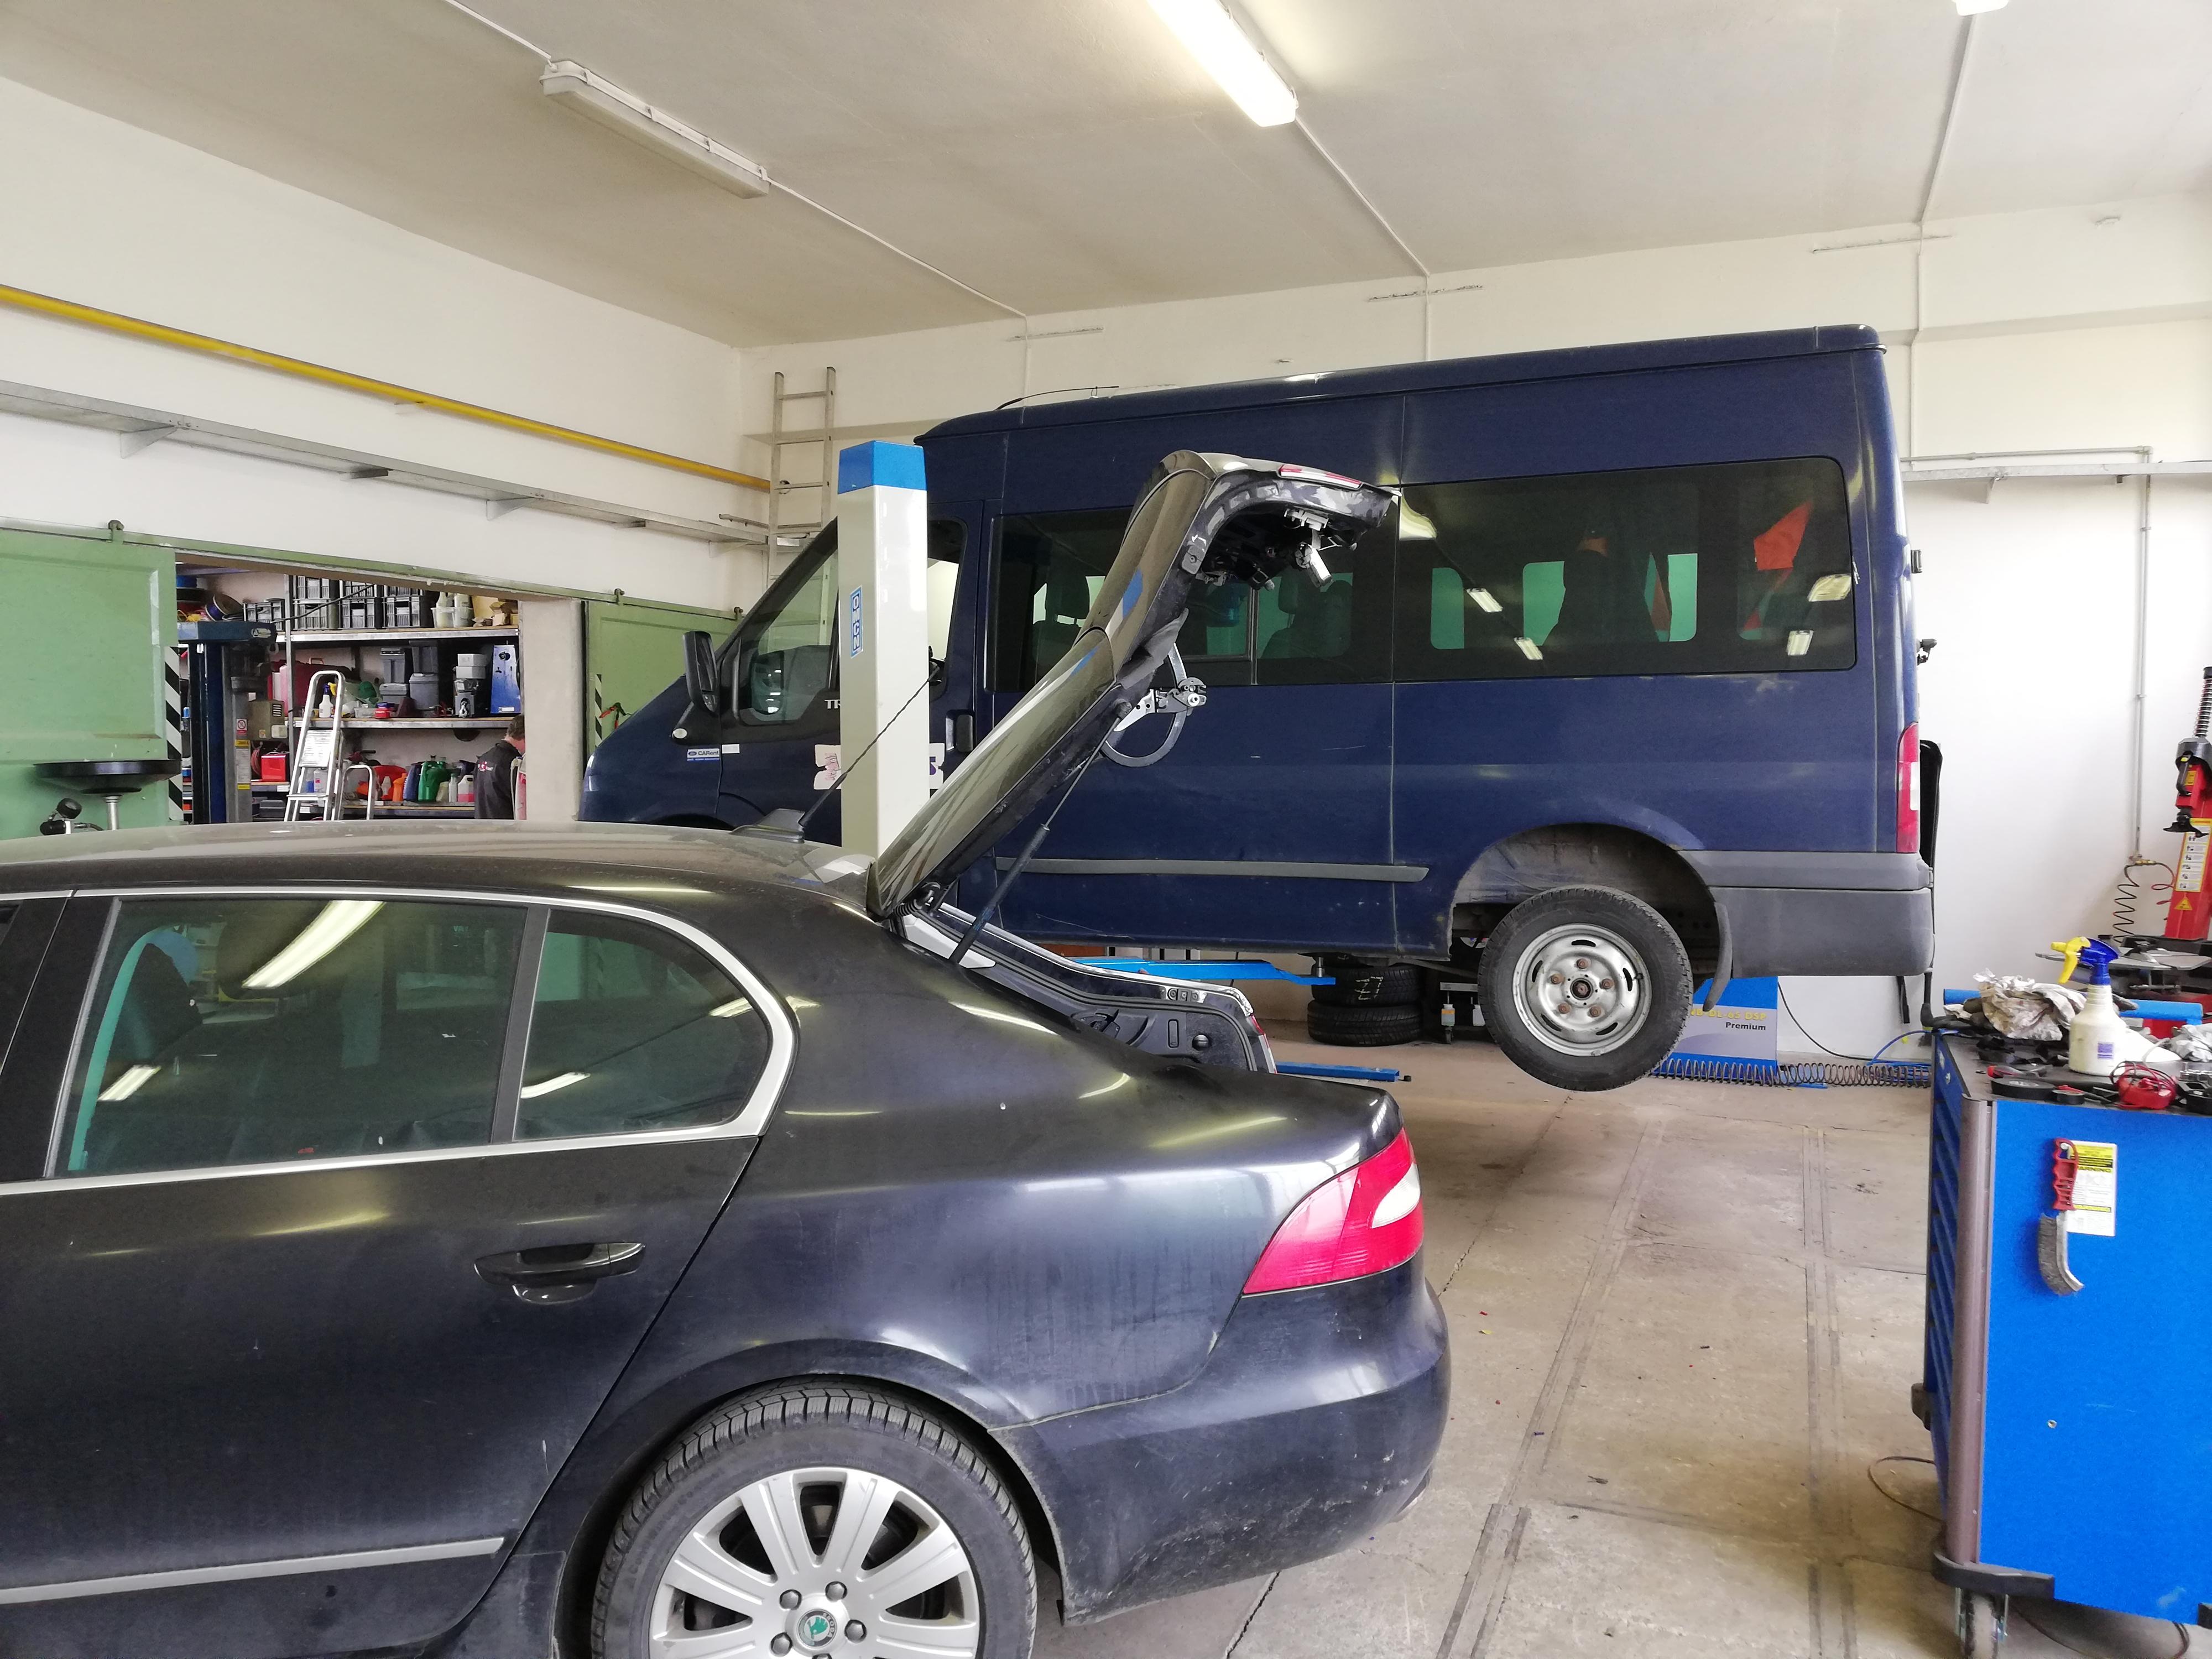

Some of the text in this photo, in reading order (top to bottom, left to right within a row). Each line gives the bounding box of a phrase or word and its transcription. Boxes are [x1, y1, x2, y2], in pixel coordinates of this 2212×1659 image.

[852, 595, 860, 650] OMCN
[1744, 1012, 1767, 1021] DSP
[1725, 1021, 1766, 1031] Premium
